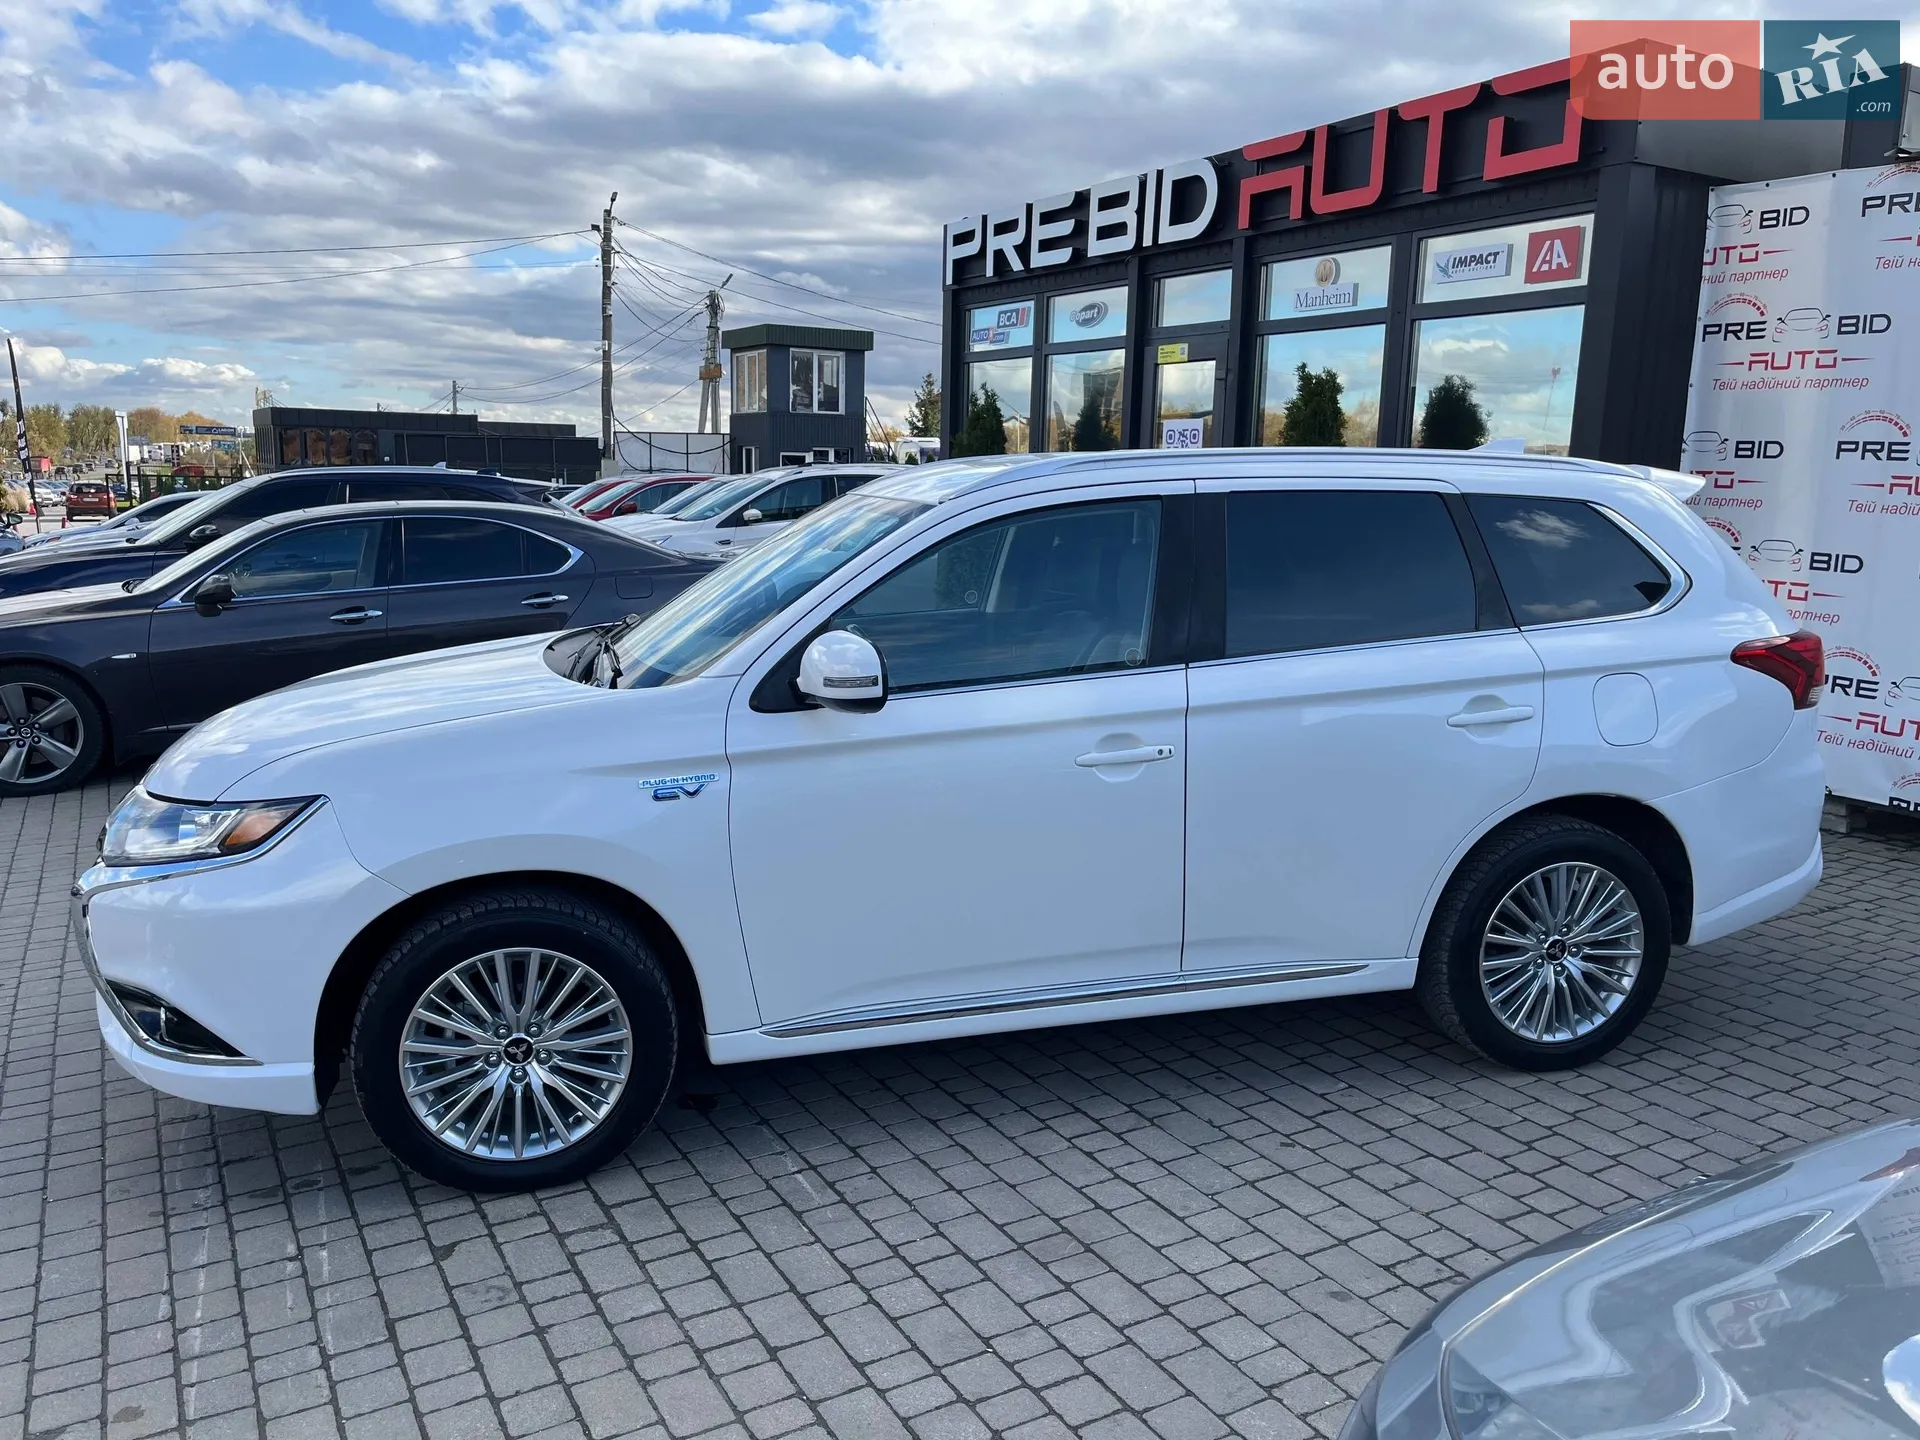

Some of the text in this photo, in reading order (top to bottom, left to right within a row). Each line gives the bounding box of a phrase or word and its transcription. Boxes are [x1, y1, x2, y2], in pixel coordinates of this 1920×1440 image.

[1238, 53, 1588, 230] AUTO
[1861, 192, 1920, 217] PR
[1759, 206, 1810, 229] BID
[1451, 251, 1500, 269] IMPACT
[1703, 243, 1760, 265] UTO
[1875, 255, 1905, 270] Твій
[1729, 269, 1788, 284] партнер
[1295, 288, 1351, 309] Manheim
[999, 311, 1017, 326] BCA
[1702, 314, 1892, 342] PRE BID
[1748, 350, 1838, 371] AUTO
[1712, 376, 1869, 391] Твій надійний партнер
[1734, 440, 1784, 459] BID
[1835, 440, 1911, 461] PRE
[1704, 497, 1763, 510] партнер
[1848, 499, 1877, 513] Твій
[1809, 552, 1864, 574] BID
[1786, 609, 1840, 626] артнер
[1856, 712, 1920, 741] AUT
[1816, 730, 1914, 759] Твій надійний
[642, 773, 716, 787] PLUG-IN HYBRID
